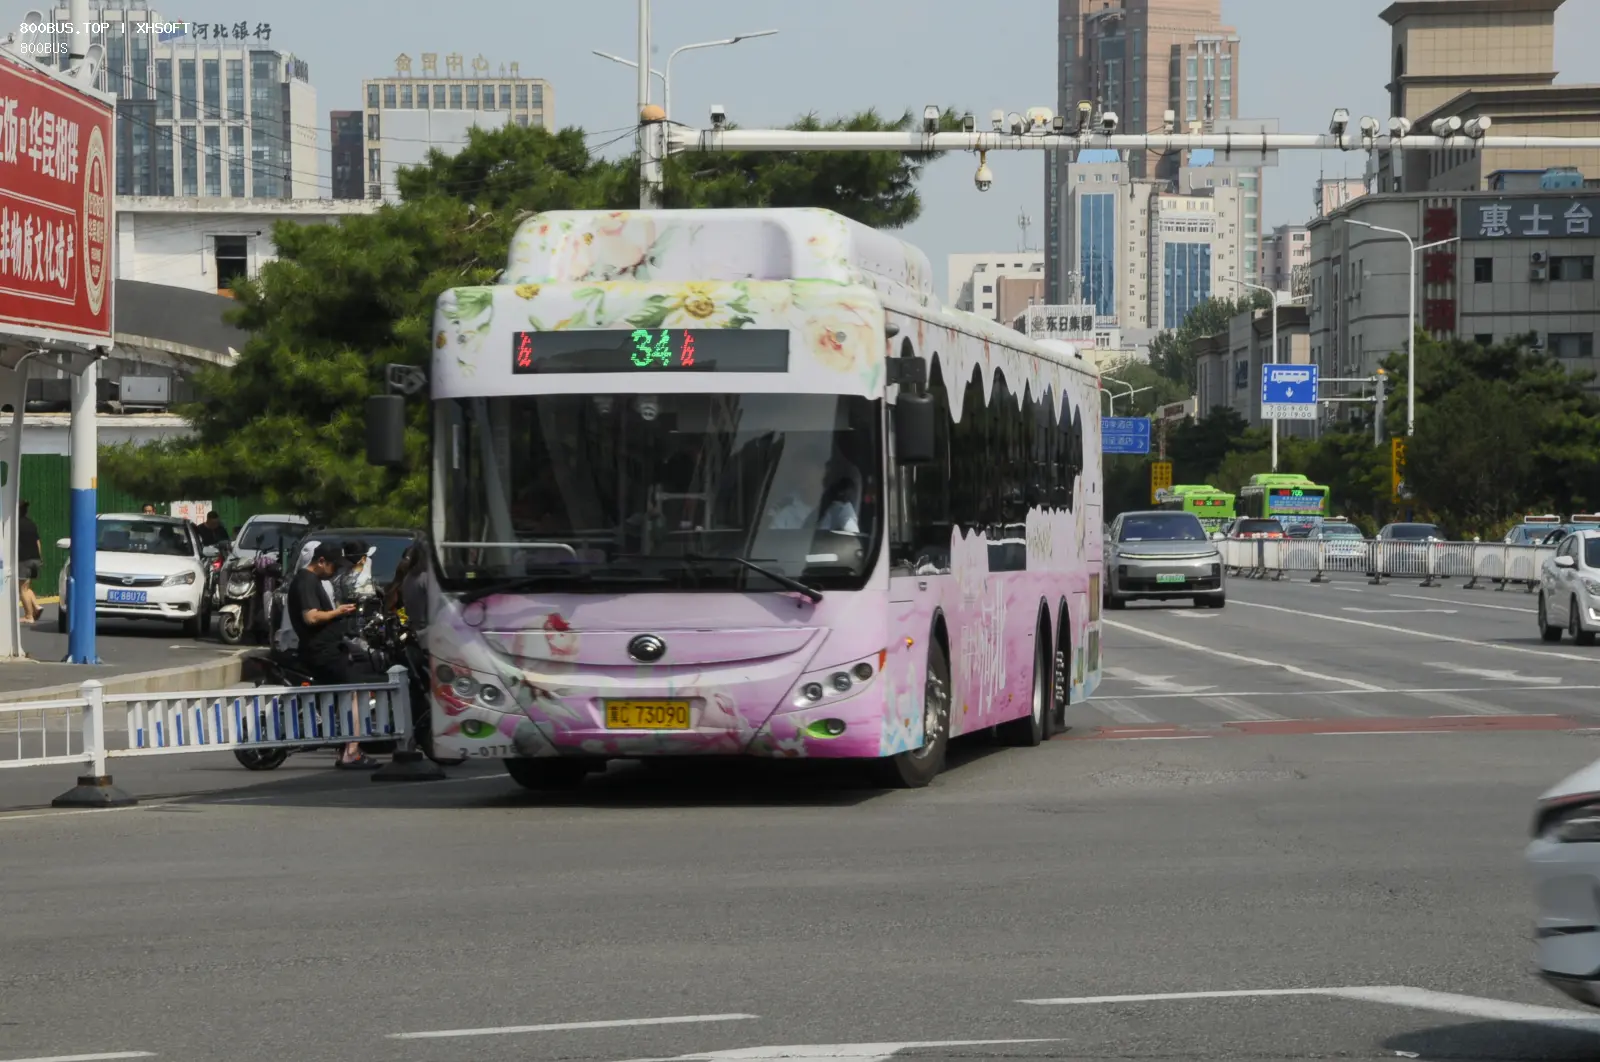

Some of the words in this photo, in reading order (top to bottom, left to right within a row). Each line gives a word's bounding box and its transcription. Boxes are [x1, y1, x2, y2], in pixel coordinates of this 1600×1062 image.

[1479, 201, 1593, 237] 惠士台
[0, 206, 74, 289] 非物质文化遗产
[1046, 316, 1092, 332] 东日集团
[631, 329, 672, 366] 34
[635, 706, 688, 724] 73090
